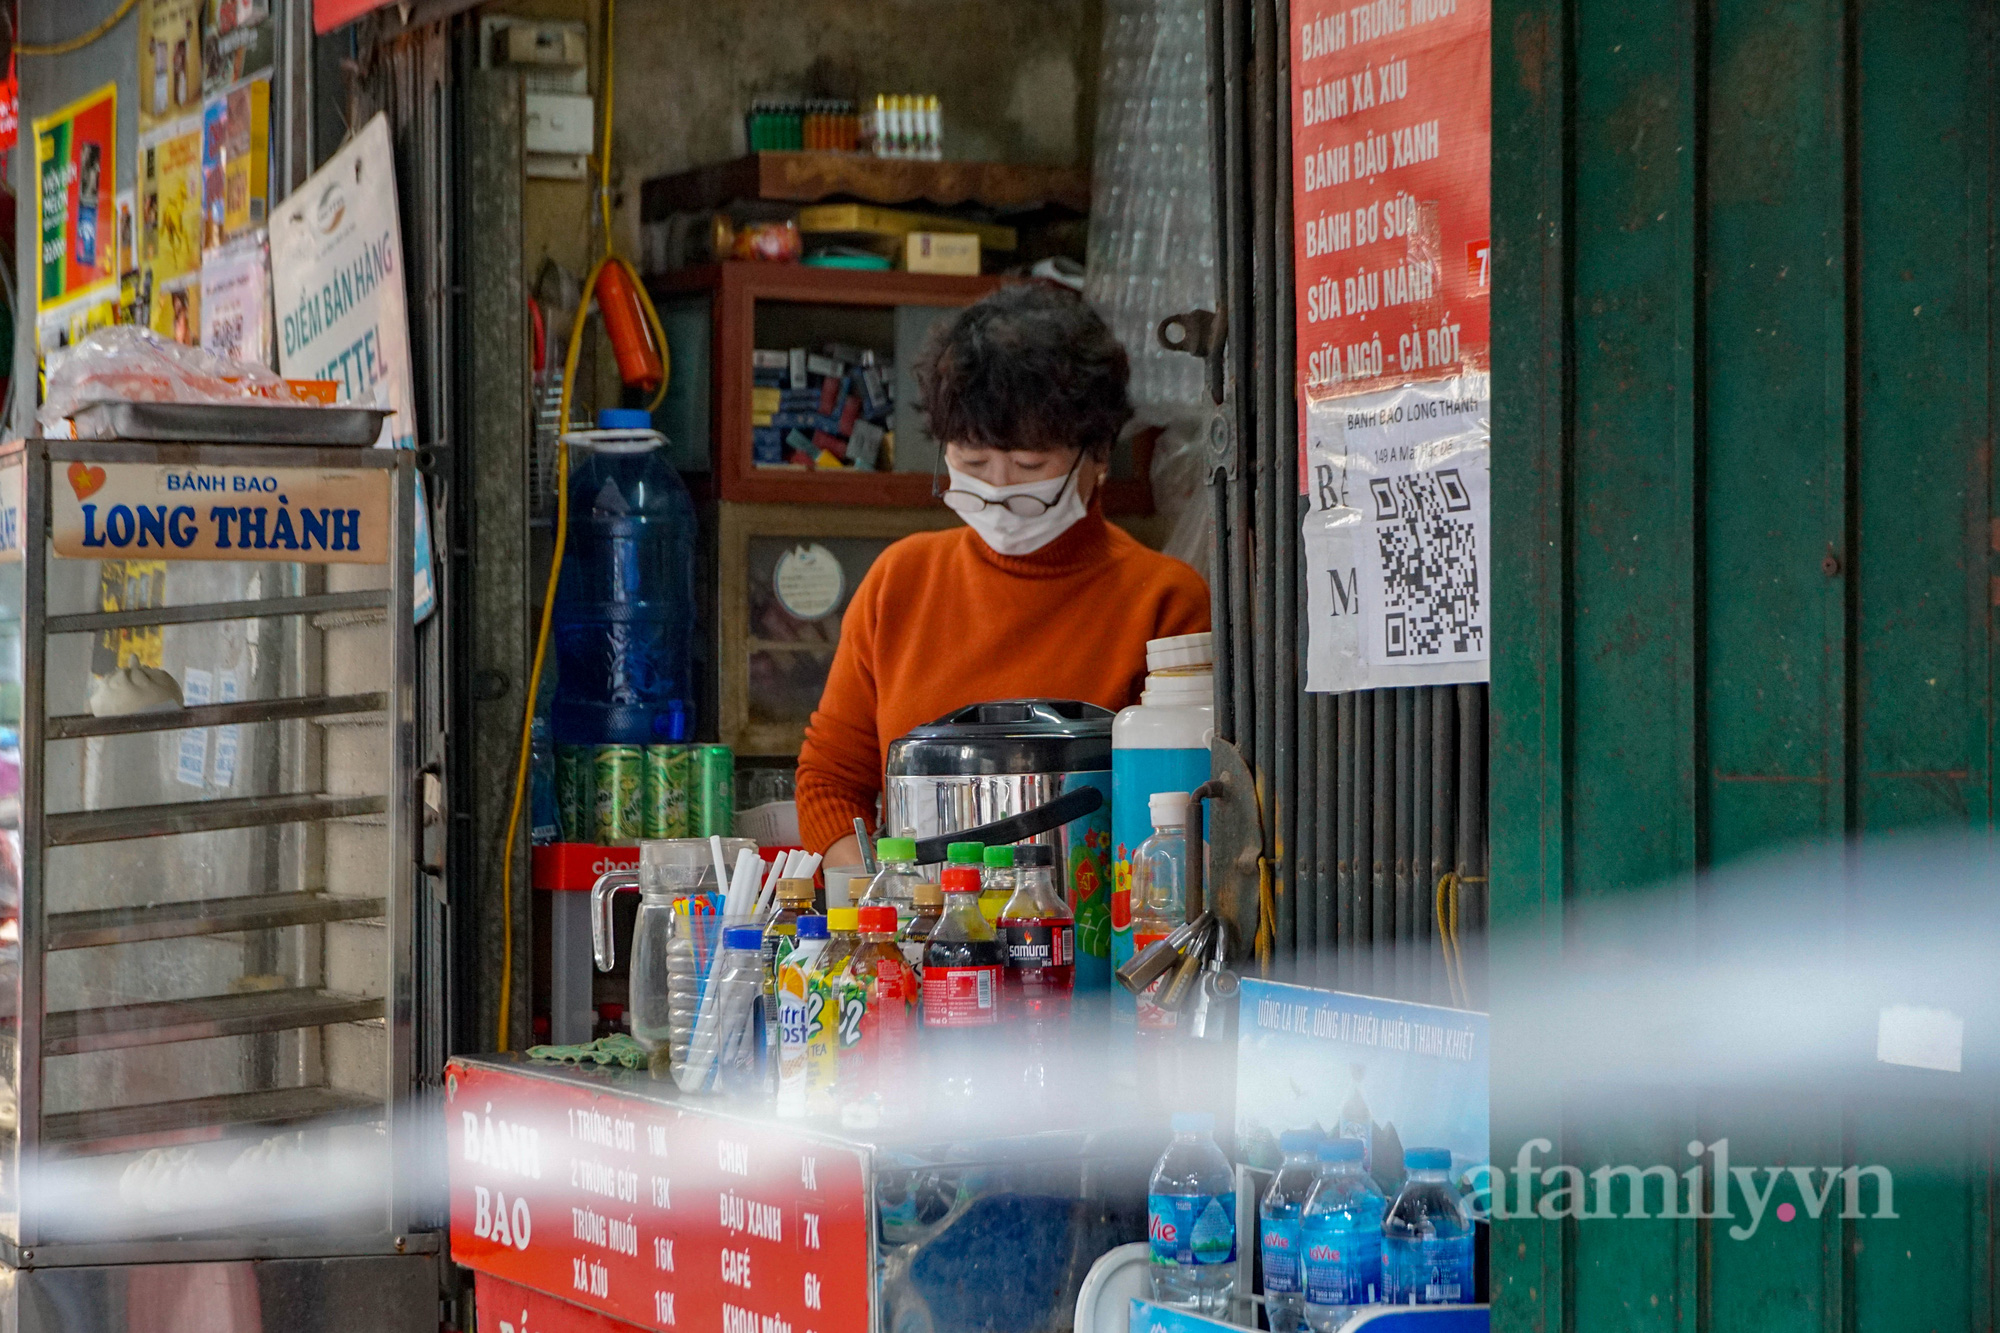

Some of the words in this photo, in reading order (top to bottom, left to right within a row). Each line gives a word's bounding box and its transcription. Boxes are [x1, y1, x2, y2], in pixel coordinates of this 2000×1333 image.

[1302, 12, 1346, 62] BÁNH
[1303, 77, 1348, 127] BÁNH
[1352, 61, 1375, 113] XÁ
[1379, 54, 1407, 105] XÍU
[1305, 143, 1350, 192] BÁNH
[1354, 129, 1387, 185] ĐẬU
[1392, 119, 1438, 169] XANH
[1306, 210, 1351, 258] BÁNH
[1356, 200, 1379, 247] BƠ
[1383, 192, 1418, 239] SỮA
[284, 287, 322, 358] ĐIỂM
[322, 265, 354, 329] BÁN
[354, 230, 393, 301] HÀNG
[1308, 275, 1341, 323] SỮA
[1345, 267, 1378, 321] ĐẬU
[1383, 258, 1433, 308] NÀNH
[1309, 342, 1342, 388] SỮA
[1347, 331, 1383, 381] NGÔ
[1399, 324, 1423, 372] CÀ
[1428, 311, 1460, 367] RỐT
[1348, 408, 1376, 430] BÁNH
[1379, 407, 1403, 425] BAO
[1407, 401, 1437, 421] LONG
[167, 470, 226, 492] BÁNH
[233, 475, 278, 493] BAO
[81, 504, 198, 548] LONG
[210, 495, 361, 551] THÀNH
[1009, 944, 1049, 957] samurai
[1257, 993, 1281, 1029] UỐNG
[1282, 1003, 1291, 1032] LA
[1313, 1002, 1338, 1040] UỐNG
[1352, 1011, 1379, 1046] THIÊN
[1381, 1015, 1410, 1050] NHIÊN
[1414, 1024, 1443, 1057] THANH
[462, 1101, 541, 1179] BÁNH
[568, 1108, 574, 1138] 1
[577, 1105, 613, 1147] TRỨNG
[614, 1114, 636, 1152] CÚT
[647, 1124, 668, 1157] 10K
[571, 1157, 578, 1187] 2
[580, 1156, 615, 1197] TRỨNG
[617, 1166, 638, 1204] CÚT
[651, 1175, 671, 1210] 13K
[718, 1139, 749, 1176] CHAY
[801, 1156, 817, 1191] 4K
[474, 1185, 531, 1250] BAO
[572, 1205, 606, 1248] TRỨNG
[609, 1213, 638, 1258] MUỐI
[654, 1236, 675, 1273] 16K
[720, 1188, 744, 1237] ĐẬU
[747, 1200, 782, 1243] XANH
[803, 1212, 820, 1250] 7K
[573, 1254, 588, 1292] XÁ
[590, 1259, 608, 1299] XÍU
[655, 1290, 675, 1326] 16K
[721, 1248, 751, 1289] CAFÉ
